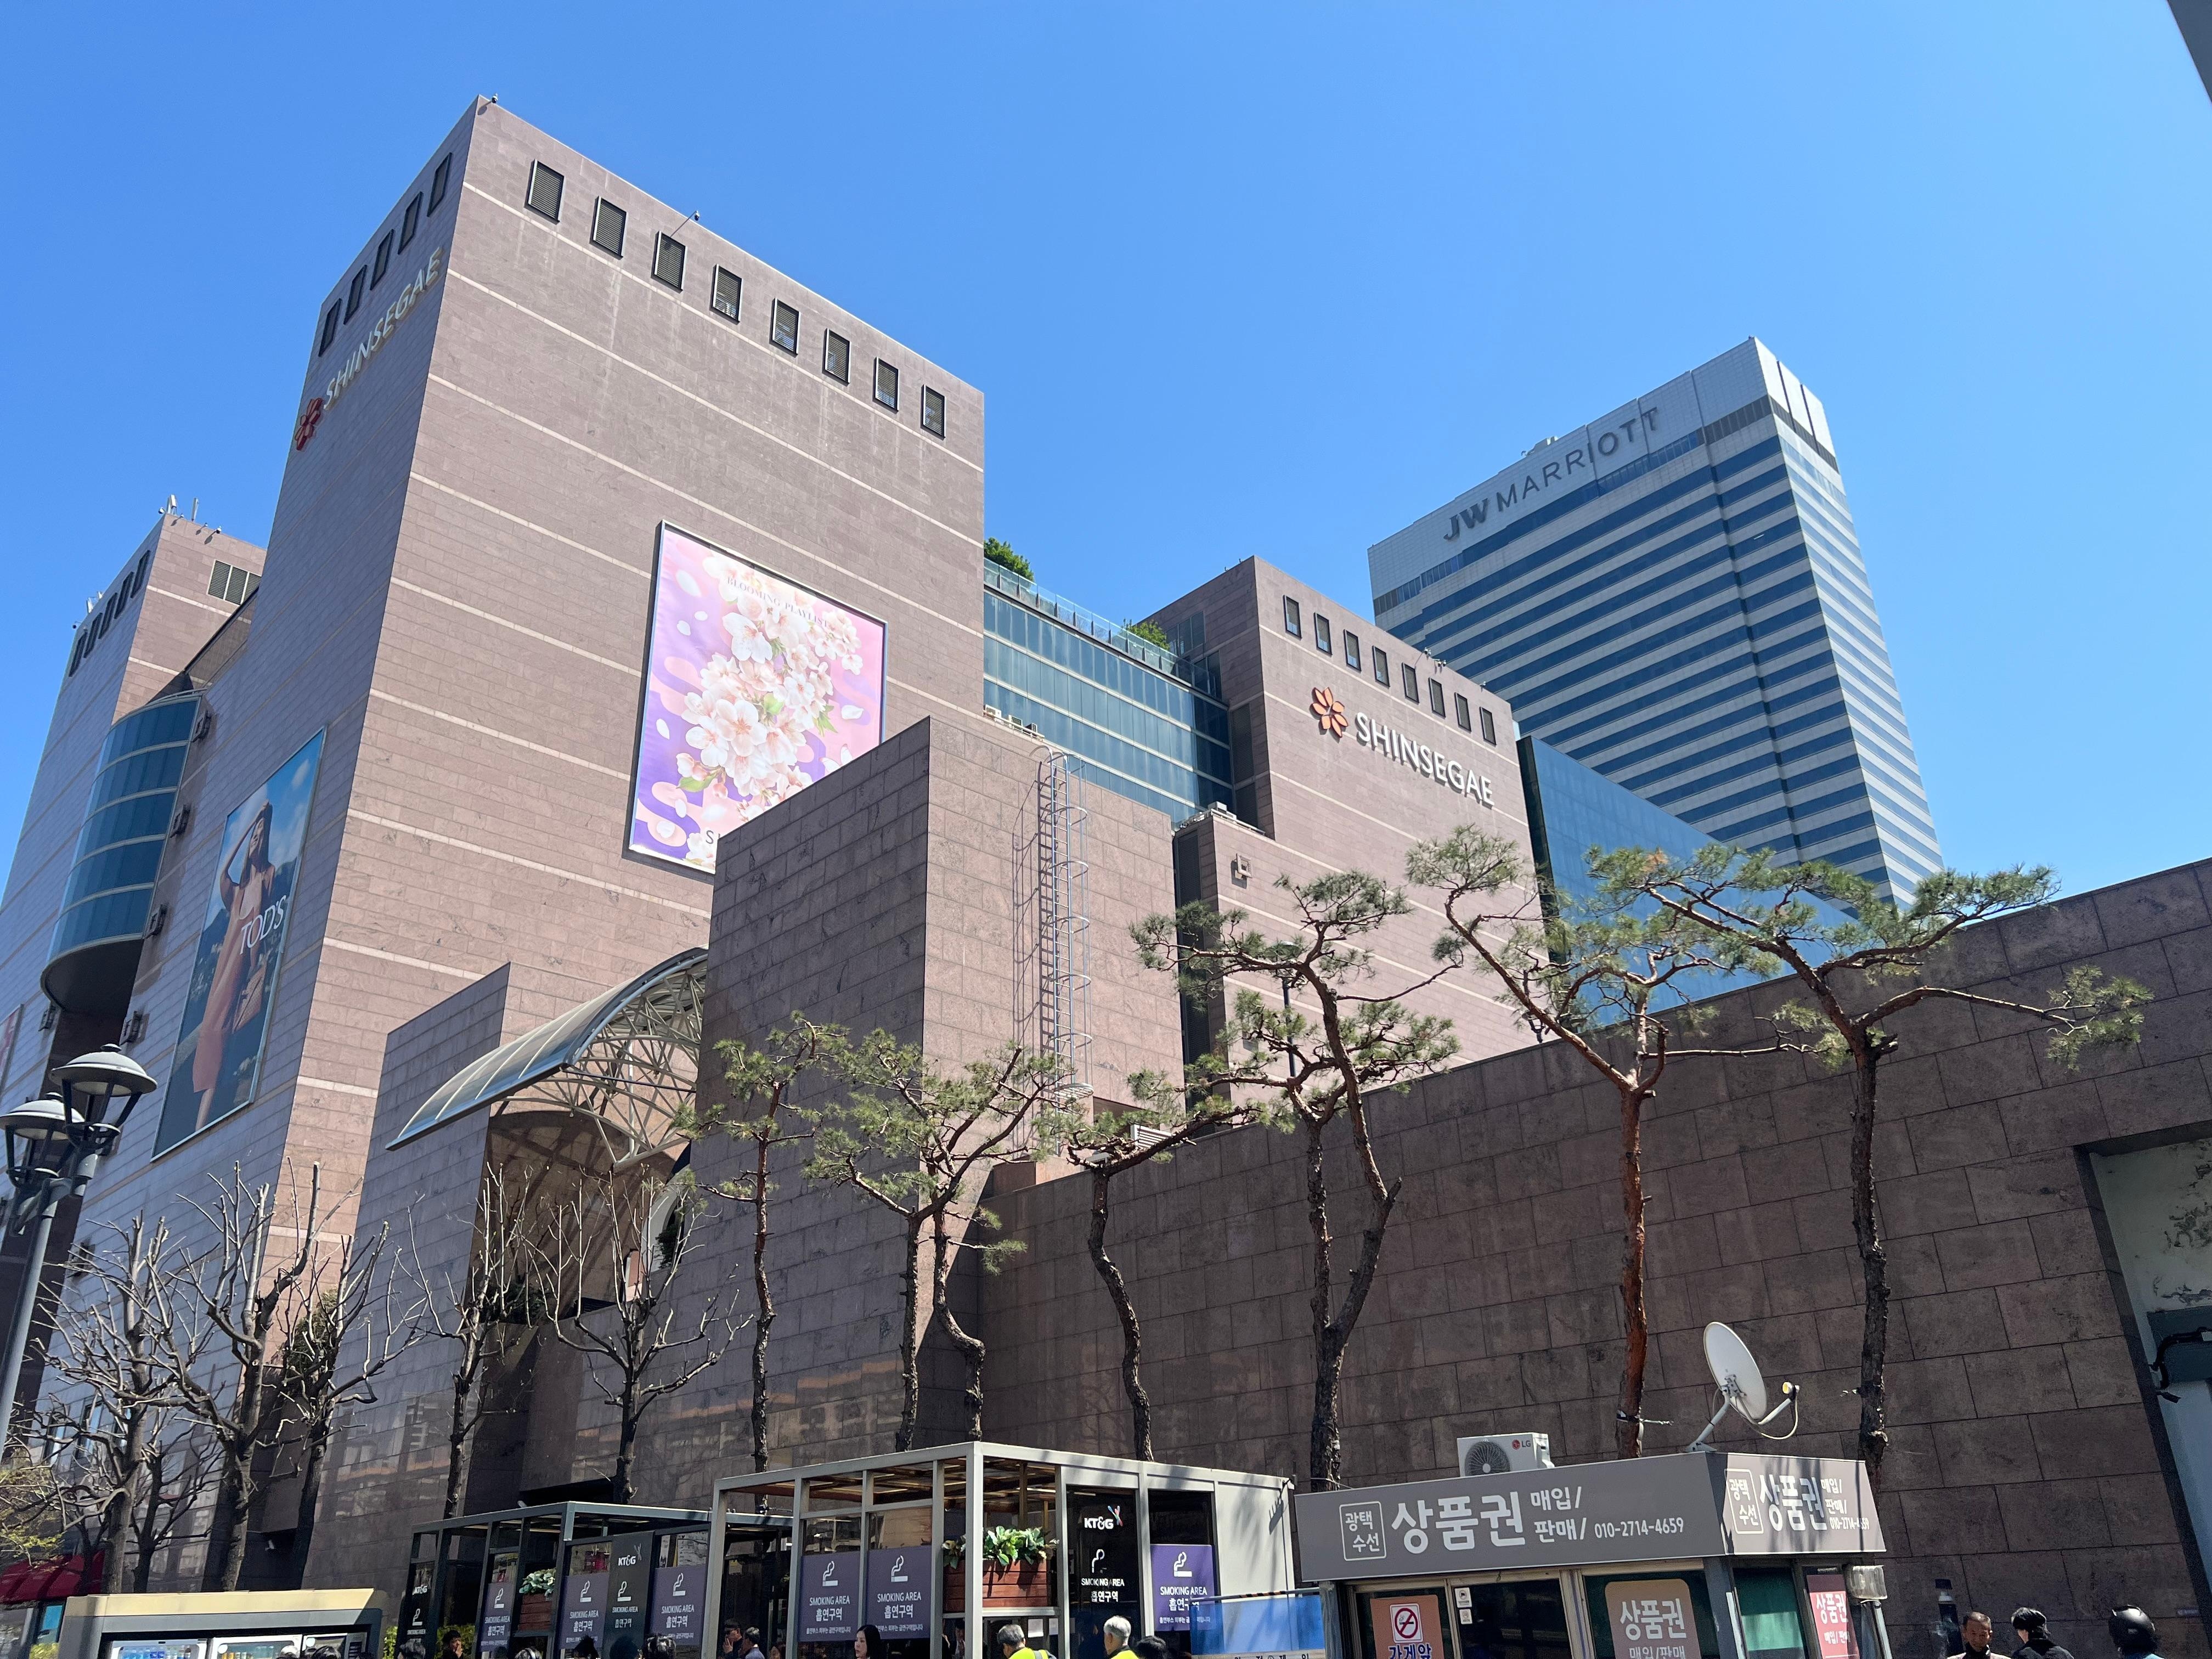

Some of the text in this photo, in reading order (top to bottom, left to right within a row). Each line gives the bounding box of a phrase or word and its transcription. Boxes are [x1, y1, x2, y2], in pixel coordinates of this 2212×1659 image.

[324, 246, 444, 410] SHINSEGAE
[1443, 407, 1658, 541] JW MARRIOTT
[727, 577, 829, 628] BLOOMING PLAYLIST
[1356, 712, 1495, 808] SHINSEGAE
[240, 895, 286, 955] TOD'S
[1530, 1486, 1582, 1511] 매입/
[1729, 1479, 1751, 1501] 광택
[1759, 1474, 1827, 1532] 상품권
[1084, 1516, 1114, 1530] KT&G
[1345, 1510, 1373, 1532] 광택
[1391, 1491, 1526, 1554] 상품권
[1739, 1504, 1759, 1526] 수선
[1534, 1517, 1684, 1543] 판매/ 010-2714-4659
[1352, 1533, 1380, 1553] 수선
[618, 1555, 636, 1566] KT&G
[1081, 1578, 1125, 1587] SMOKING AREA
[1160, 1586, 1207, 1595] SMOKING AREA
[809, 1595, 850, 1606] SMOKING AREA
[877, 1592, 922, 1602] SMOKING AREA
[1091, 1590, 1119, 1602] 흡연구역
[569, 1610, 599, 1619] SMOKING AREA
[661, 1604, 695, 1613] SMOKING AREA
[815, 1607, 843, 1622] 흡연구역
[884, 1604, 913, 1619] 흡연구역
[1620, 1598, 1687, 1640] 상품권
[1816, 1593, 1849, 1624] 상품권
[573, 1620, 593, 1632] 흡연구역
[666, 1615, 688, 1628] 흡연구역
